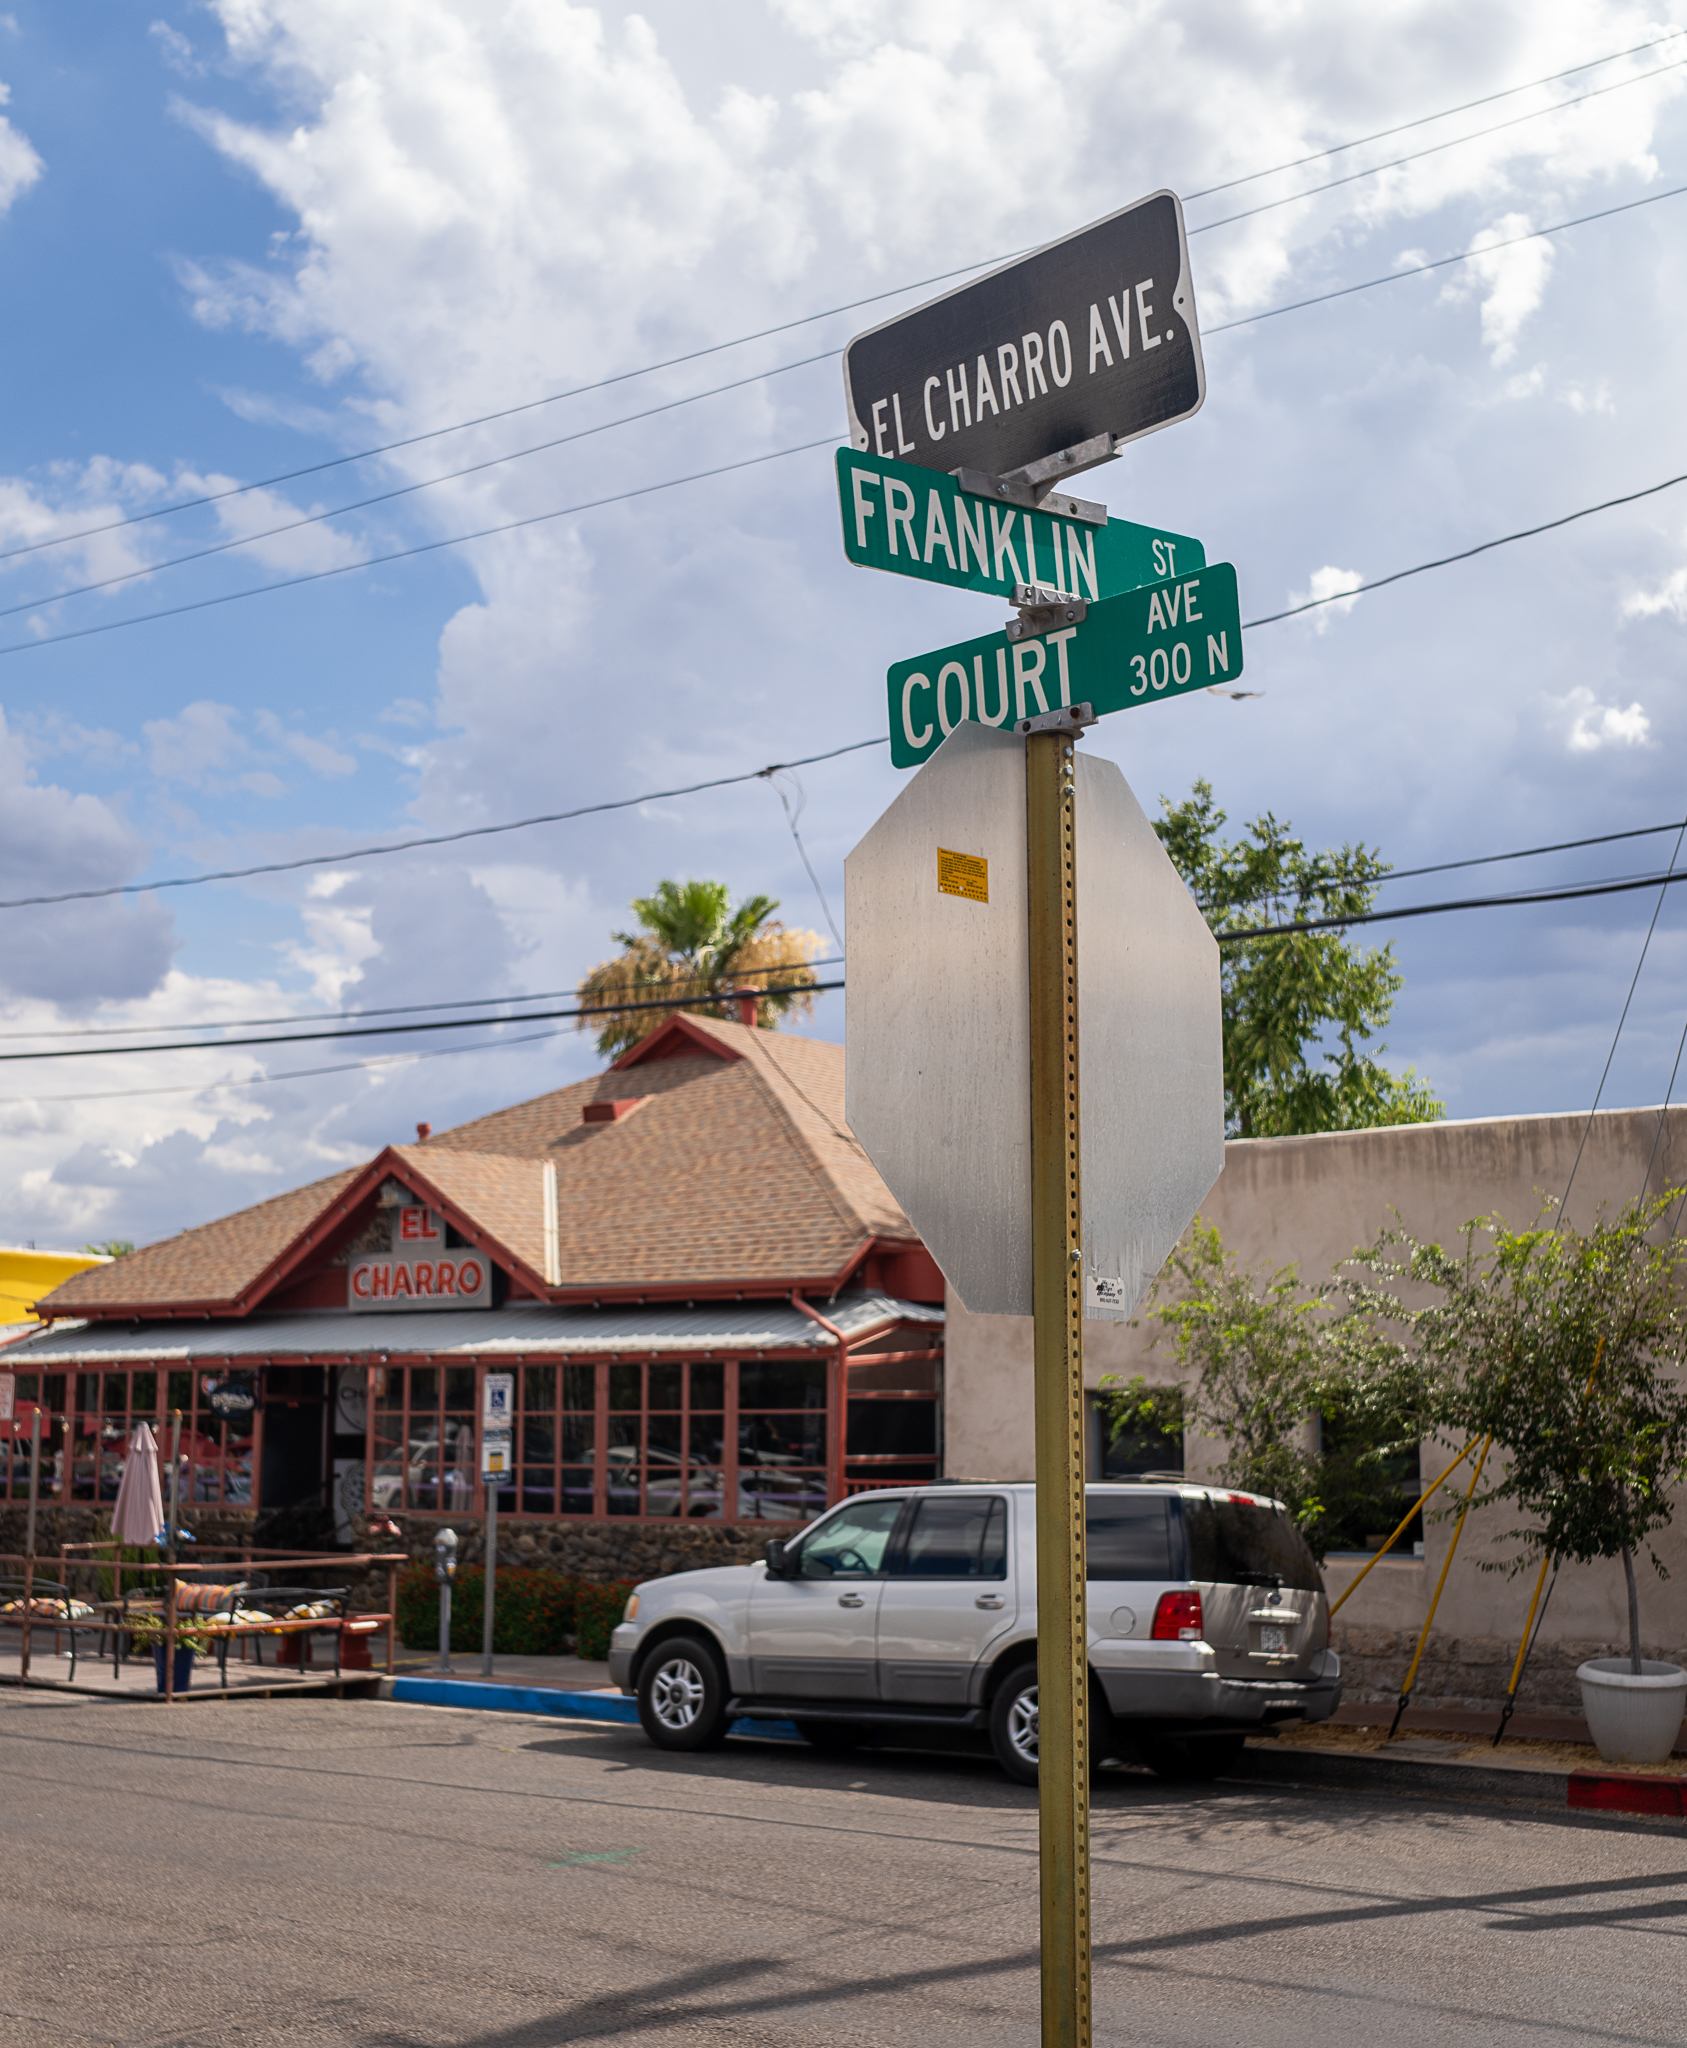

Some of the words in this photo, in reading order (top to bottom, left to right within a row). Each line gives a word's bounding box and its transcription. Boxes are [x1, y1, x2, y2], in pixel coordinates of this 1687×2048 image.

[872, 393, 915, 459] EL
[924, 319, 1073, 441] CHARRO
[1089, 278, 1174, 374] AVE.
[851, 467, 1099, 602] FRANKLIN
[1153, 538, 1176, 578] ST
[901, 627, 1077, 748] COURT
[1147, 579, 1203, 634] AVE
[1130, 642, 1192, 696] 300
[1207, 631, 1229, 676] N
[401, 1206, 439, 1241] EL
[351, 1257, 485, 1300] CHARRO
